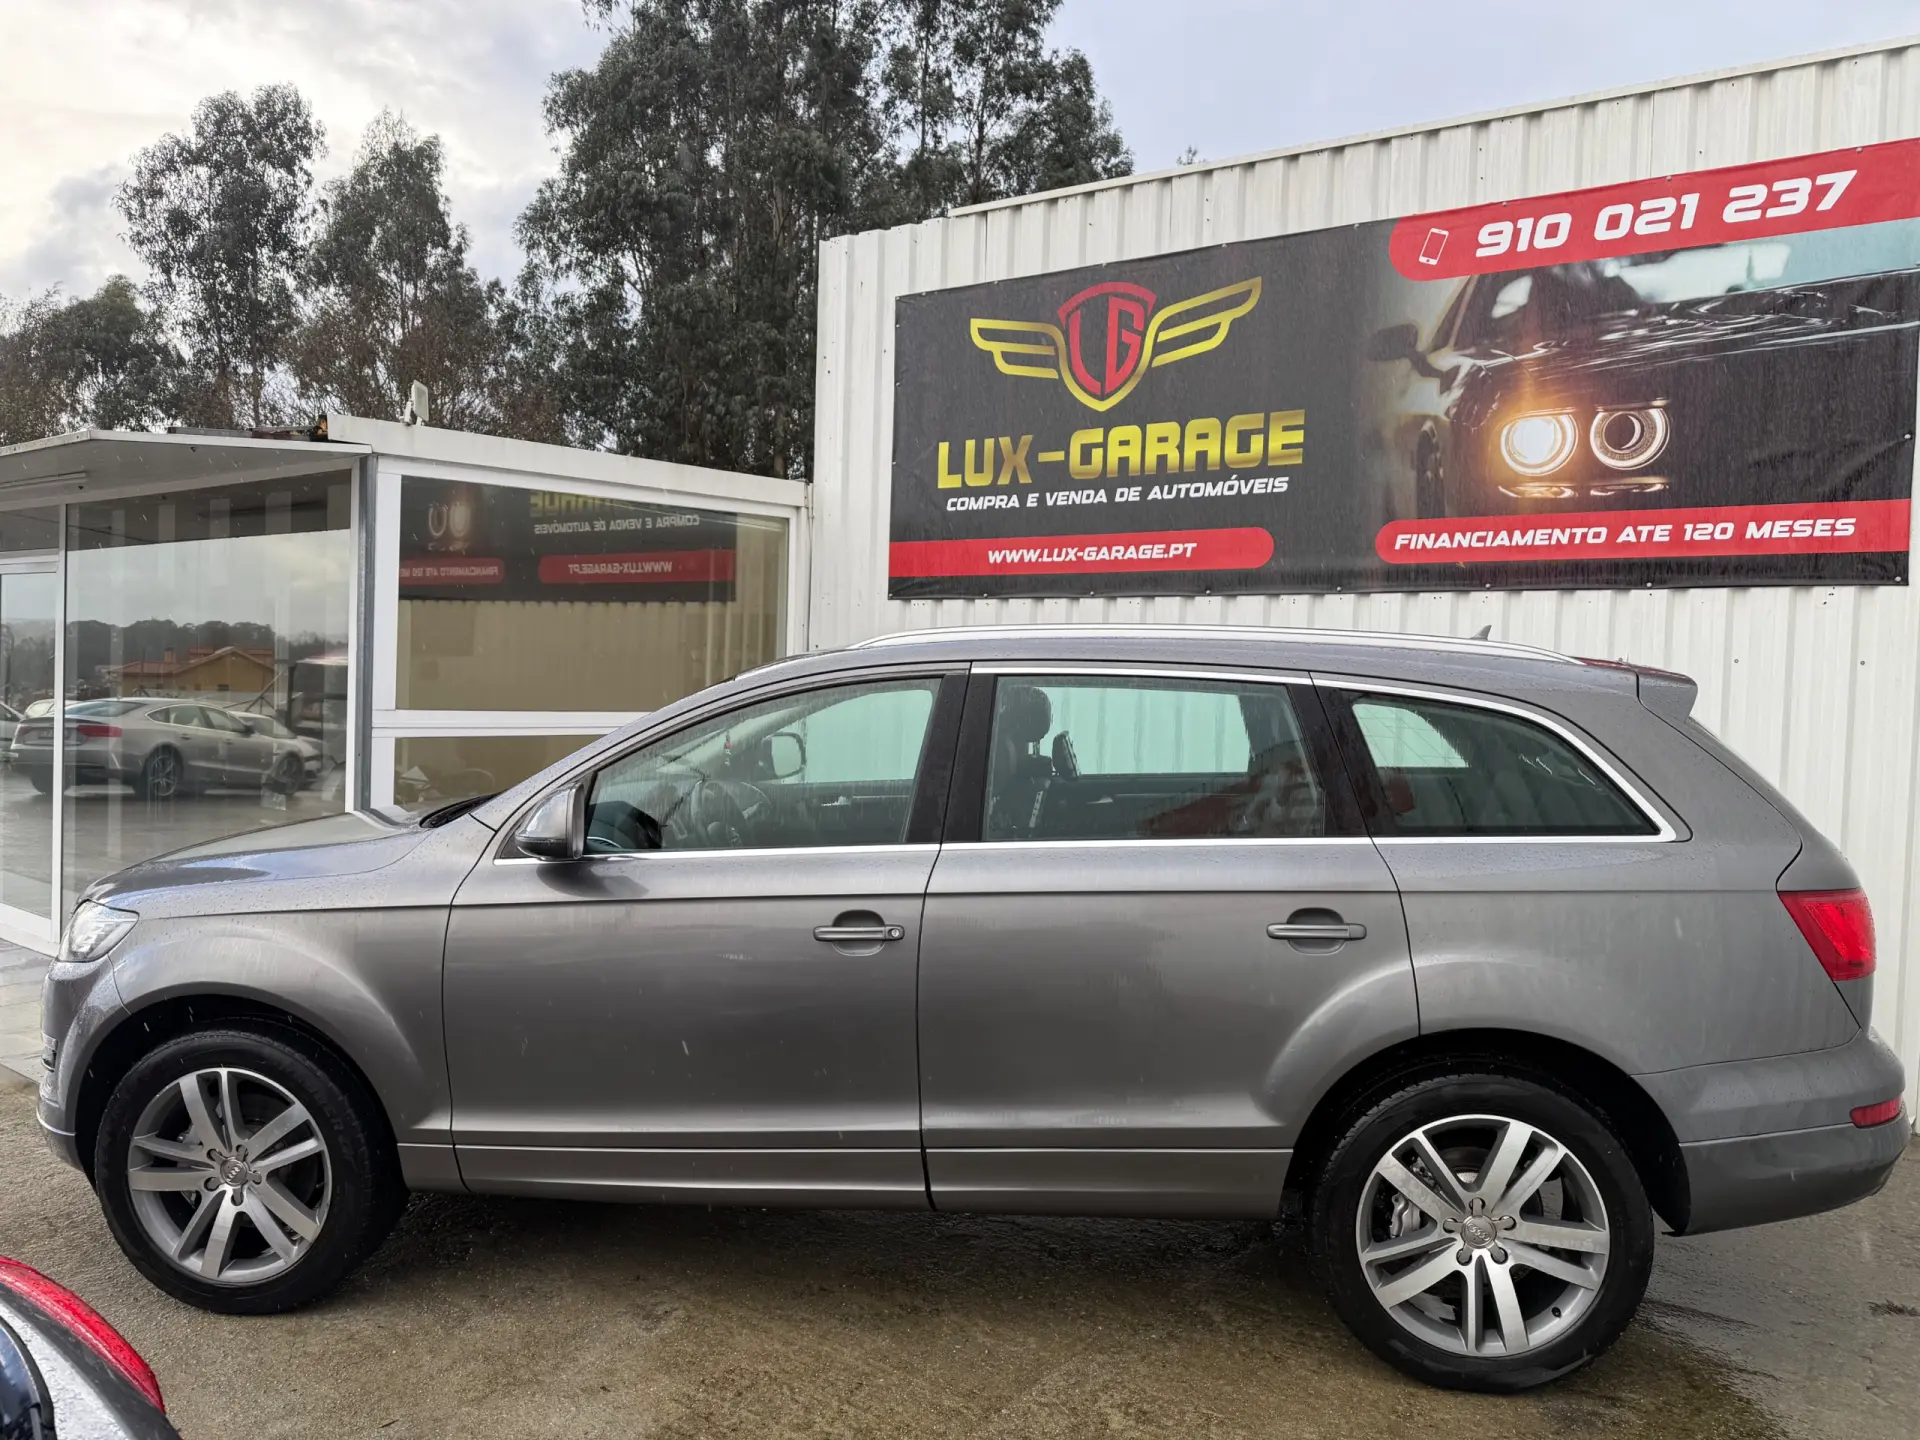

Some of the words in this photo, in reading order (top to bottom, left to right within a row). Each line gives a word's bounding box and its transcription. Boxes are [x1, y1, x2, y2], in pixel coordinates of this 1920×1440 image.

[1475, 211, 1573, 258] 910
[1593, 193, 1700, 241] 021
[1721, 169, 1858, 223] 237
[937, 409, 1306, 489] LUX-GARAGE
[946, 493, 1020, 512] COMPRA
[1026, 492, 1039, 508] E
[1045, 488, 1108, 507] VENDA
[1114, 486, 1142, 503] DE
[1146, 474, 1290, 501] AUTOMÓVEIS
[1394, 526, 1608, 550] FINANCIAMENTO
[1615, 524, 1673, 543] ATE
[1683, 522, 1735, 541] 120
[1745, 517, 1857, 539] MESES
[988, 542, 1198, 564] WWW.LUX-GARAGE.PT
